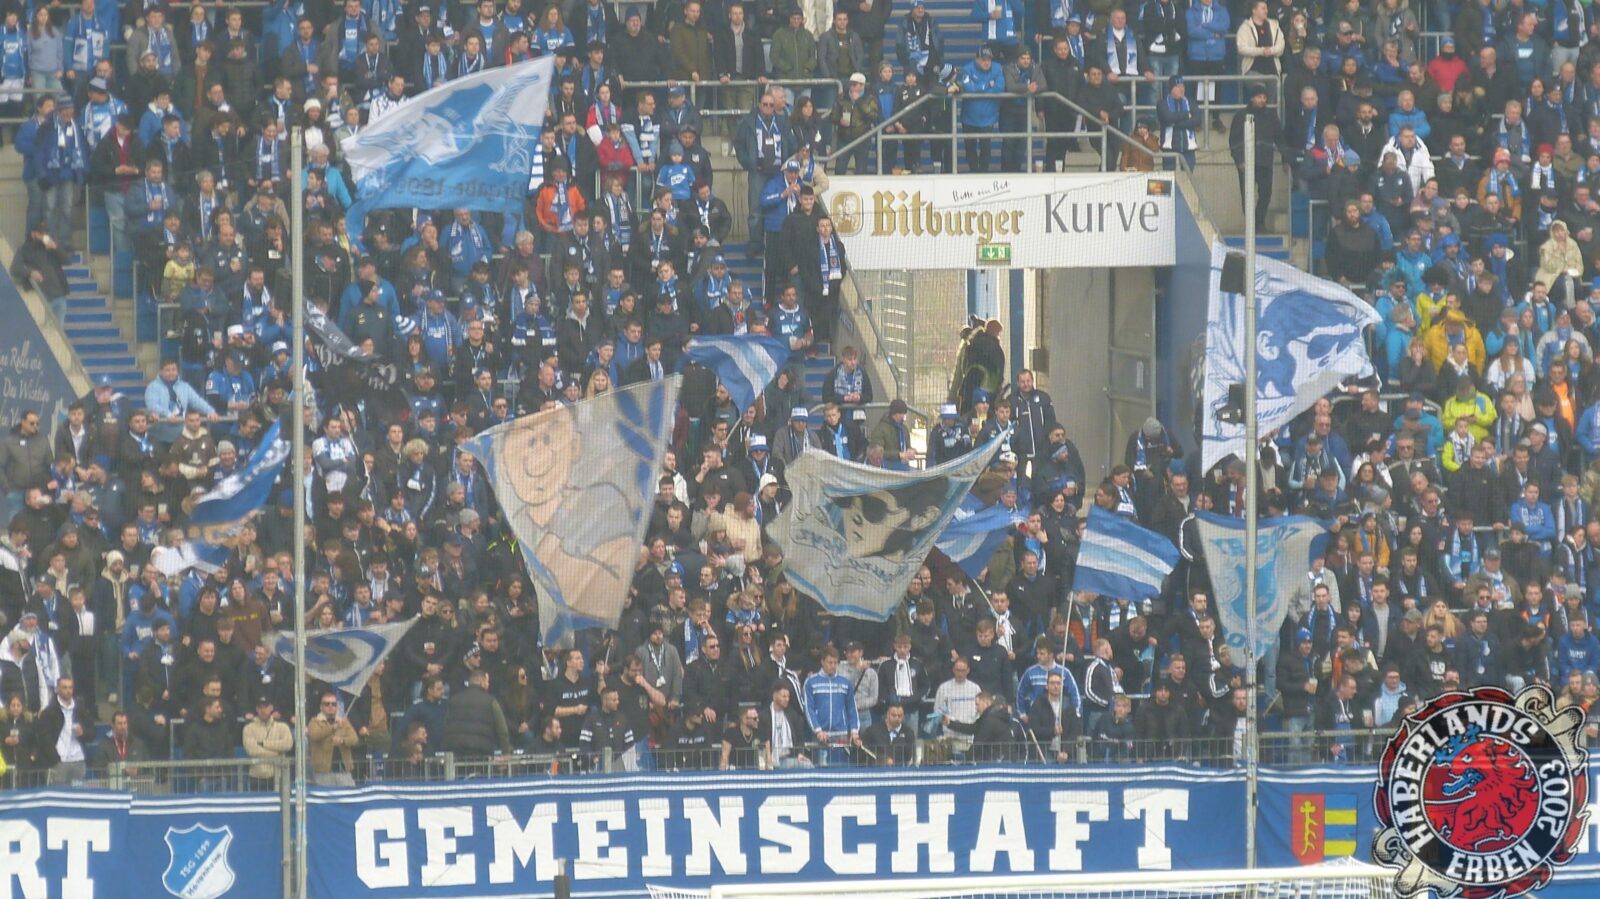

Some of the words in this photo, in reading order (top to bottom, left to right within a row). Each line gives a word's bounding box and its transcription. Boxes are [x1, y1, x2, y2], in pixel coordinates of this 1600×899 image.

[871, 190, 1025, 245] Bitburger
[1044, 193, 1160, 234] Kurve
[355, 788, 1189, 889] GEMEINSCHAFT
